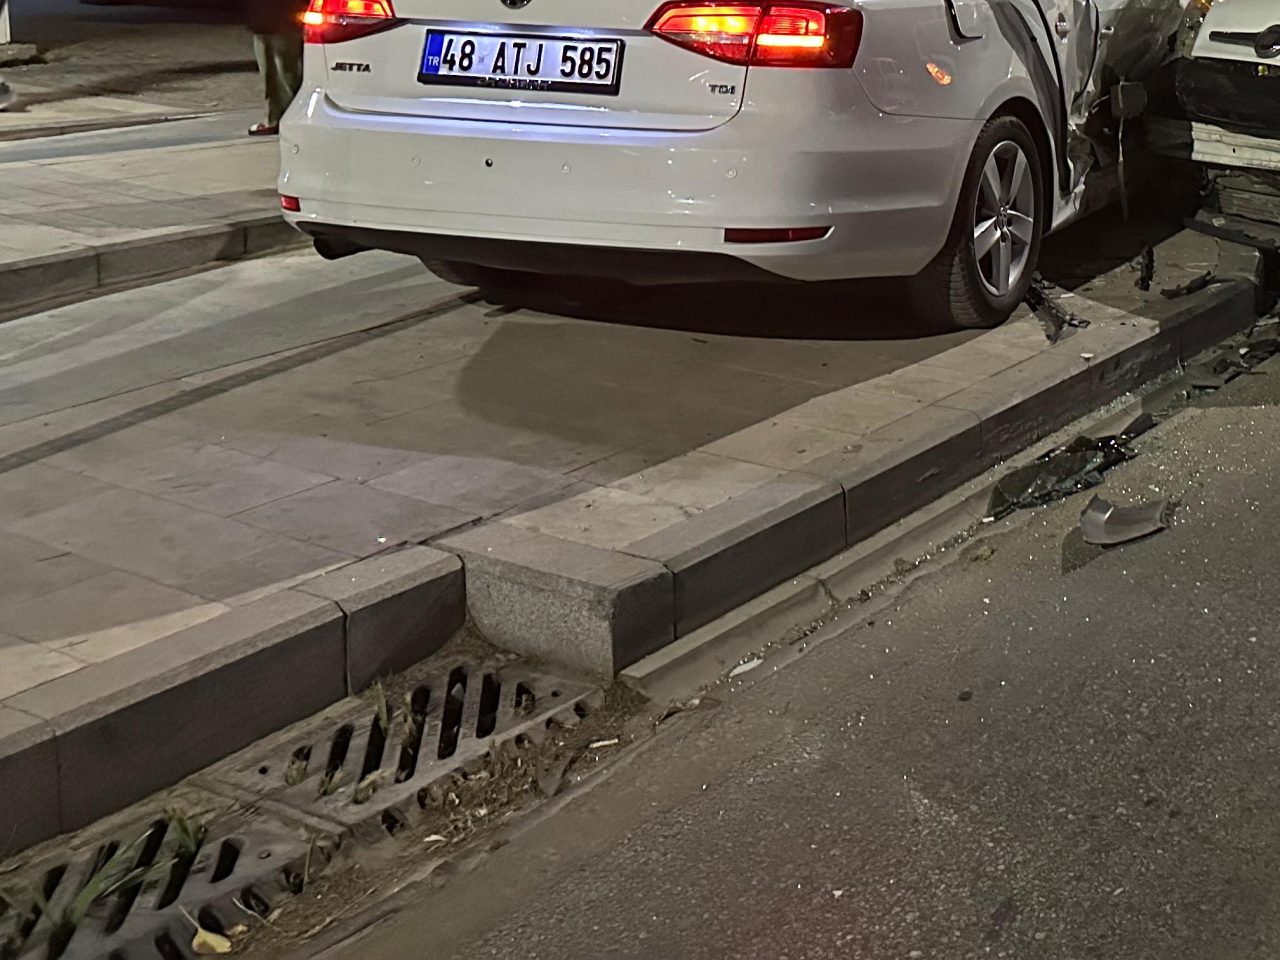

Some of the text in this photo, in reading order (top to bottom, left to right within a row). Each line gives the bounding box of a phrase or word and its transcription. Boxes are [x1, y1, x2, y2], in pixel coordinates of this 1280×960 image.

[428, 38, 613, 79] TR 48 ATJ 585
[331, 62, 371, 72] JETTA
[709, 84, 736, 95] TDI
